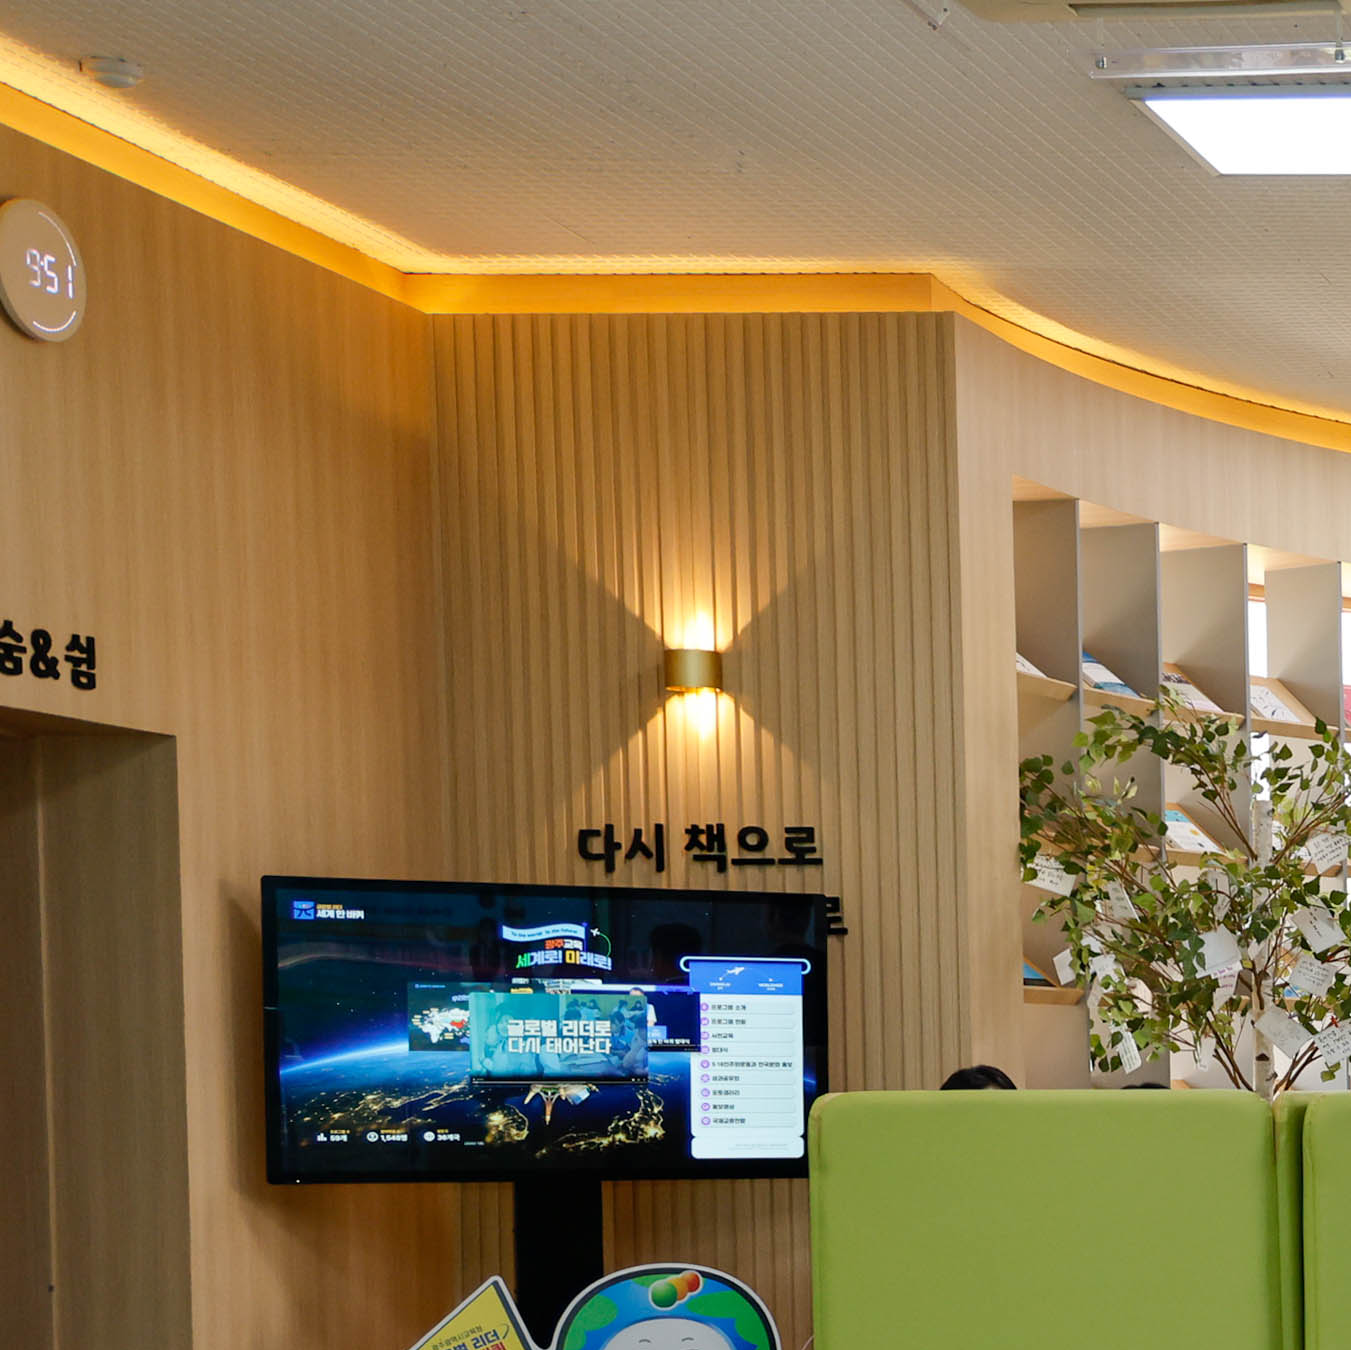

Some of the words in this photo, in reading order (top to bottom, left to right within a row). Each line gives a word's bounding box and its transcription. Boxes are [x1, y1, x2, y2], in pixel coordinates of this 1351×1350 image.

[578, 823, 664, 873] 다시
[684, 823, 823, 873] 책으로
[516, 950, 563, 969] 세계로!
[565, 950, 612, 971] 미래로!
[508, 1019, 558, 1037] 글로벌
[562, 1019, 612, 1037] 리더로
[508, 1037, 542, 1054] 다시
[545, 1037, 612, 1055] 태어난다
[470, 1329, 500, 1350] 리더
